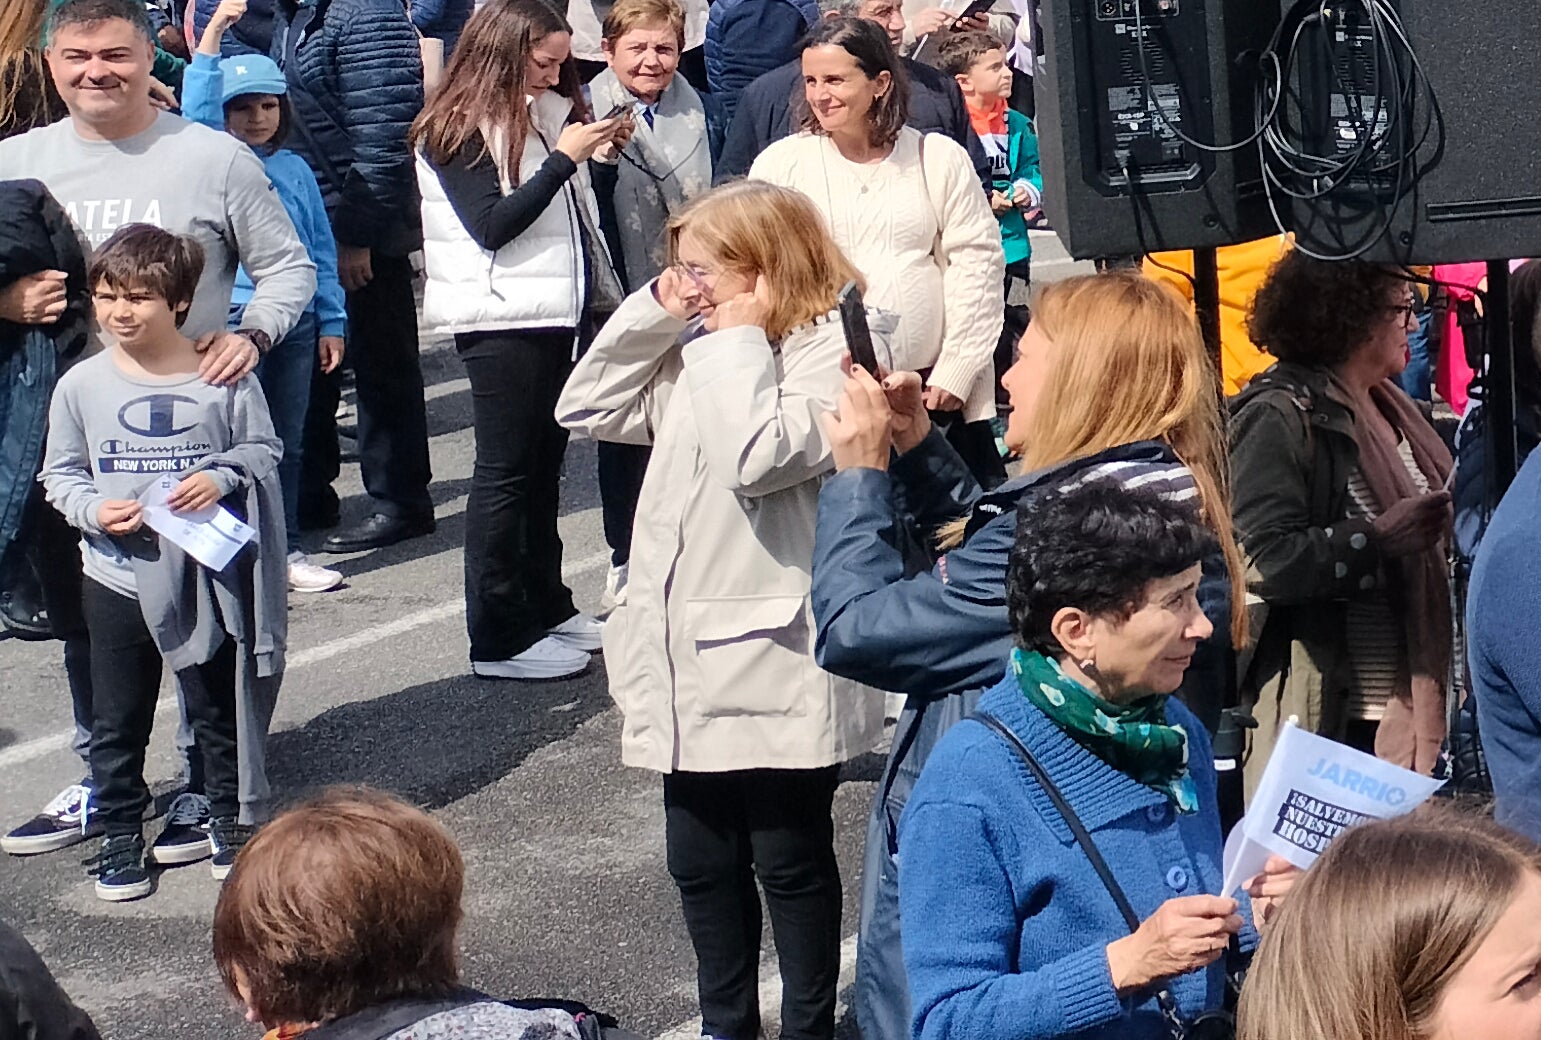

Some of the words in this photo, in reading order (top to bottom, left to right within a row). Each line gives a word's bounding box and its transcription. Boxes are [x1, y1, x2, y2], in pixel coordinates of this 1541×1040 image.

[100, 439, 211, 458] Champion
[113, 460, 139, 471] NEW
[141, 459, 178, 471] YORK
[1307, 758, 1407, 807] JARRIO
[1278, 820, 1332, 853] HOSP
[1285, 806, 1346, 838] NUESTR
